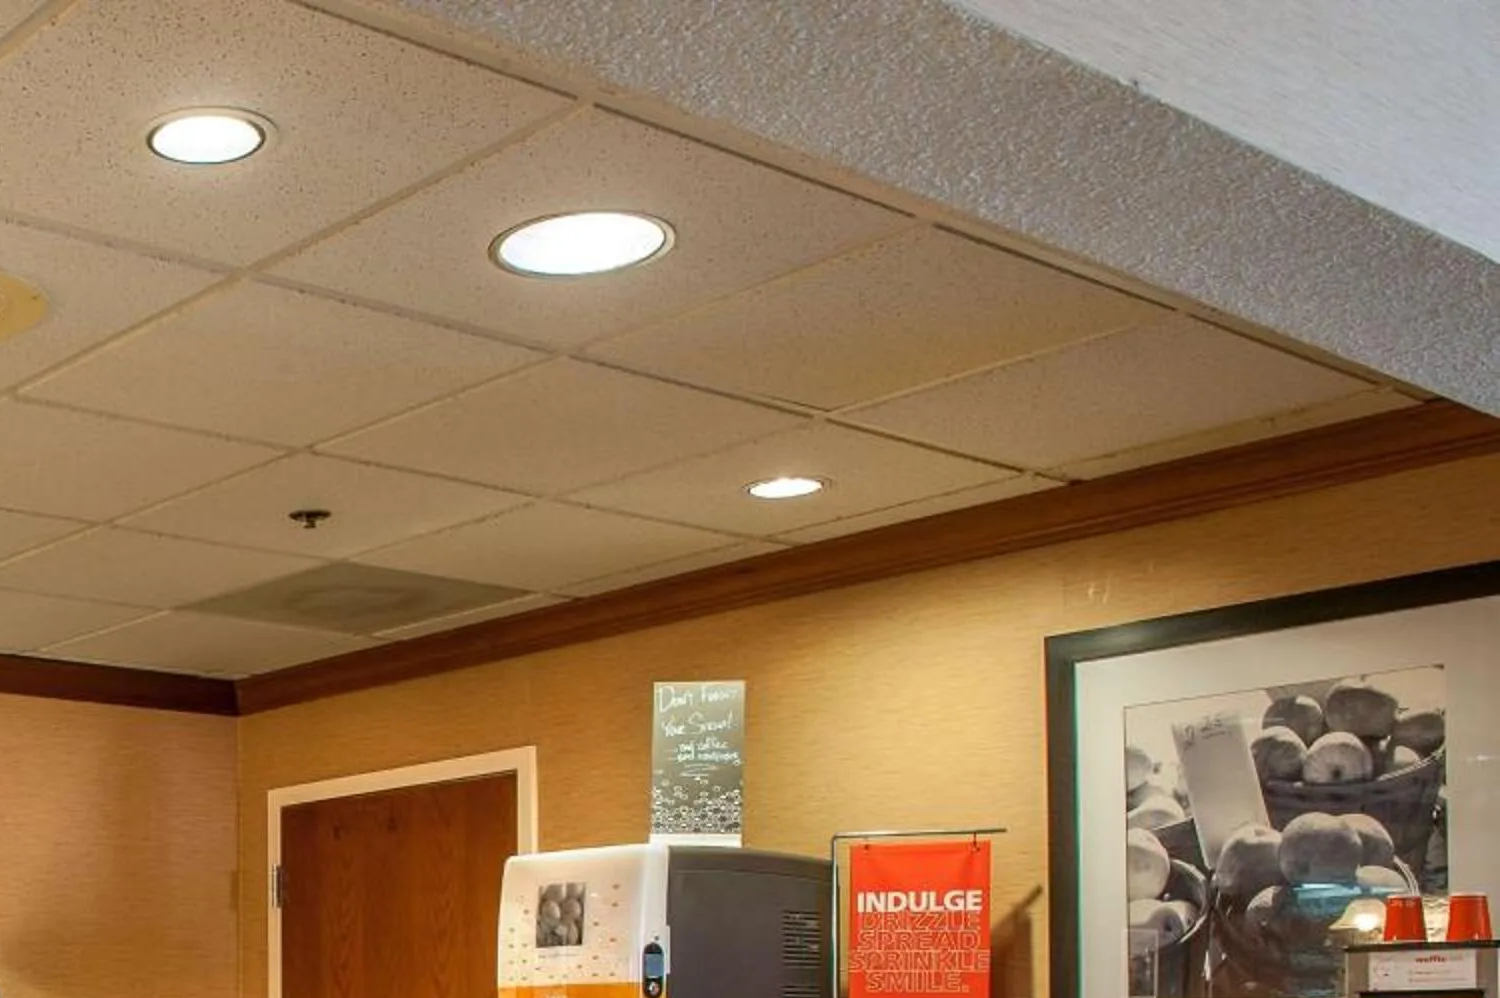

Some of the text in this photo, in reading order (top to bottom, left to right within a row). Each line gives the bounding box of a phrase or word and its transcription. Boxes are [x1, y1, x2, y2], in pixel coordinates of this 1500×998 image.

[857, 889, 983, 913] INDULGE
[861, 911, 981, 932] DRIZZLE
[857, 929, 982, 952] SPREAD
[848, 949, 990, 973] SPRINKLE
[866, 970, 970, 993] SMILE.
